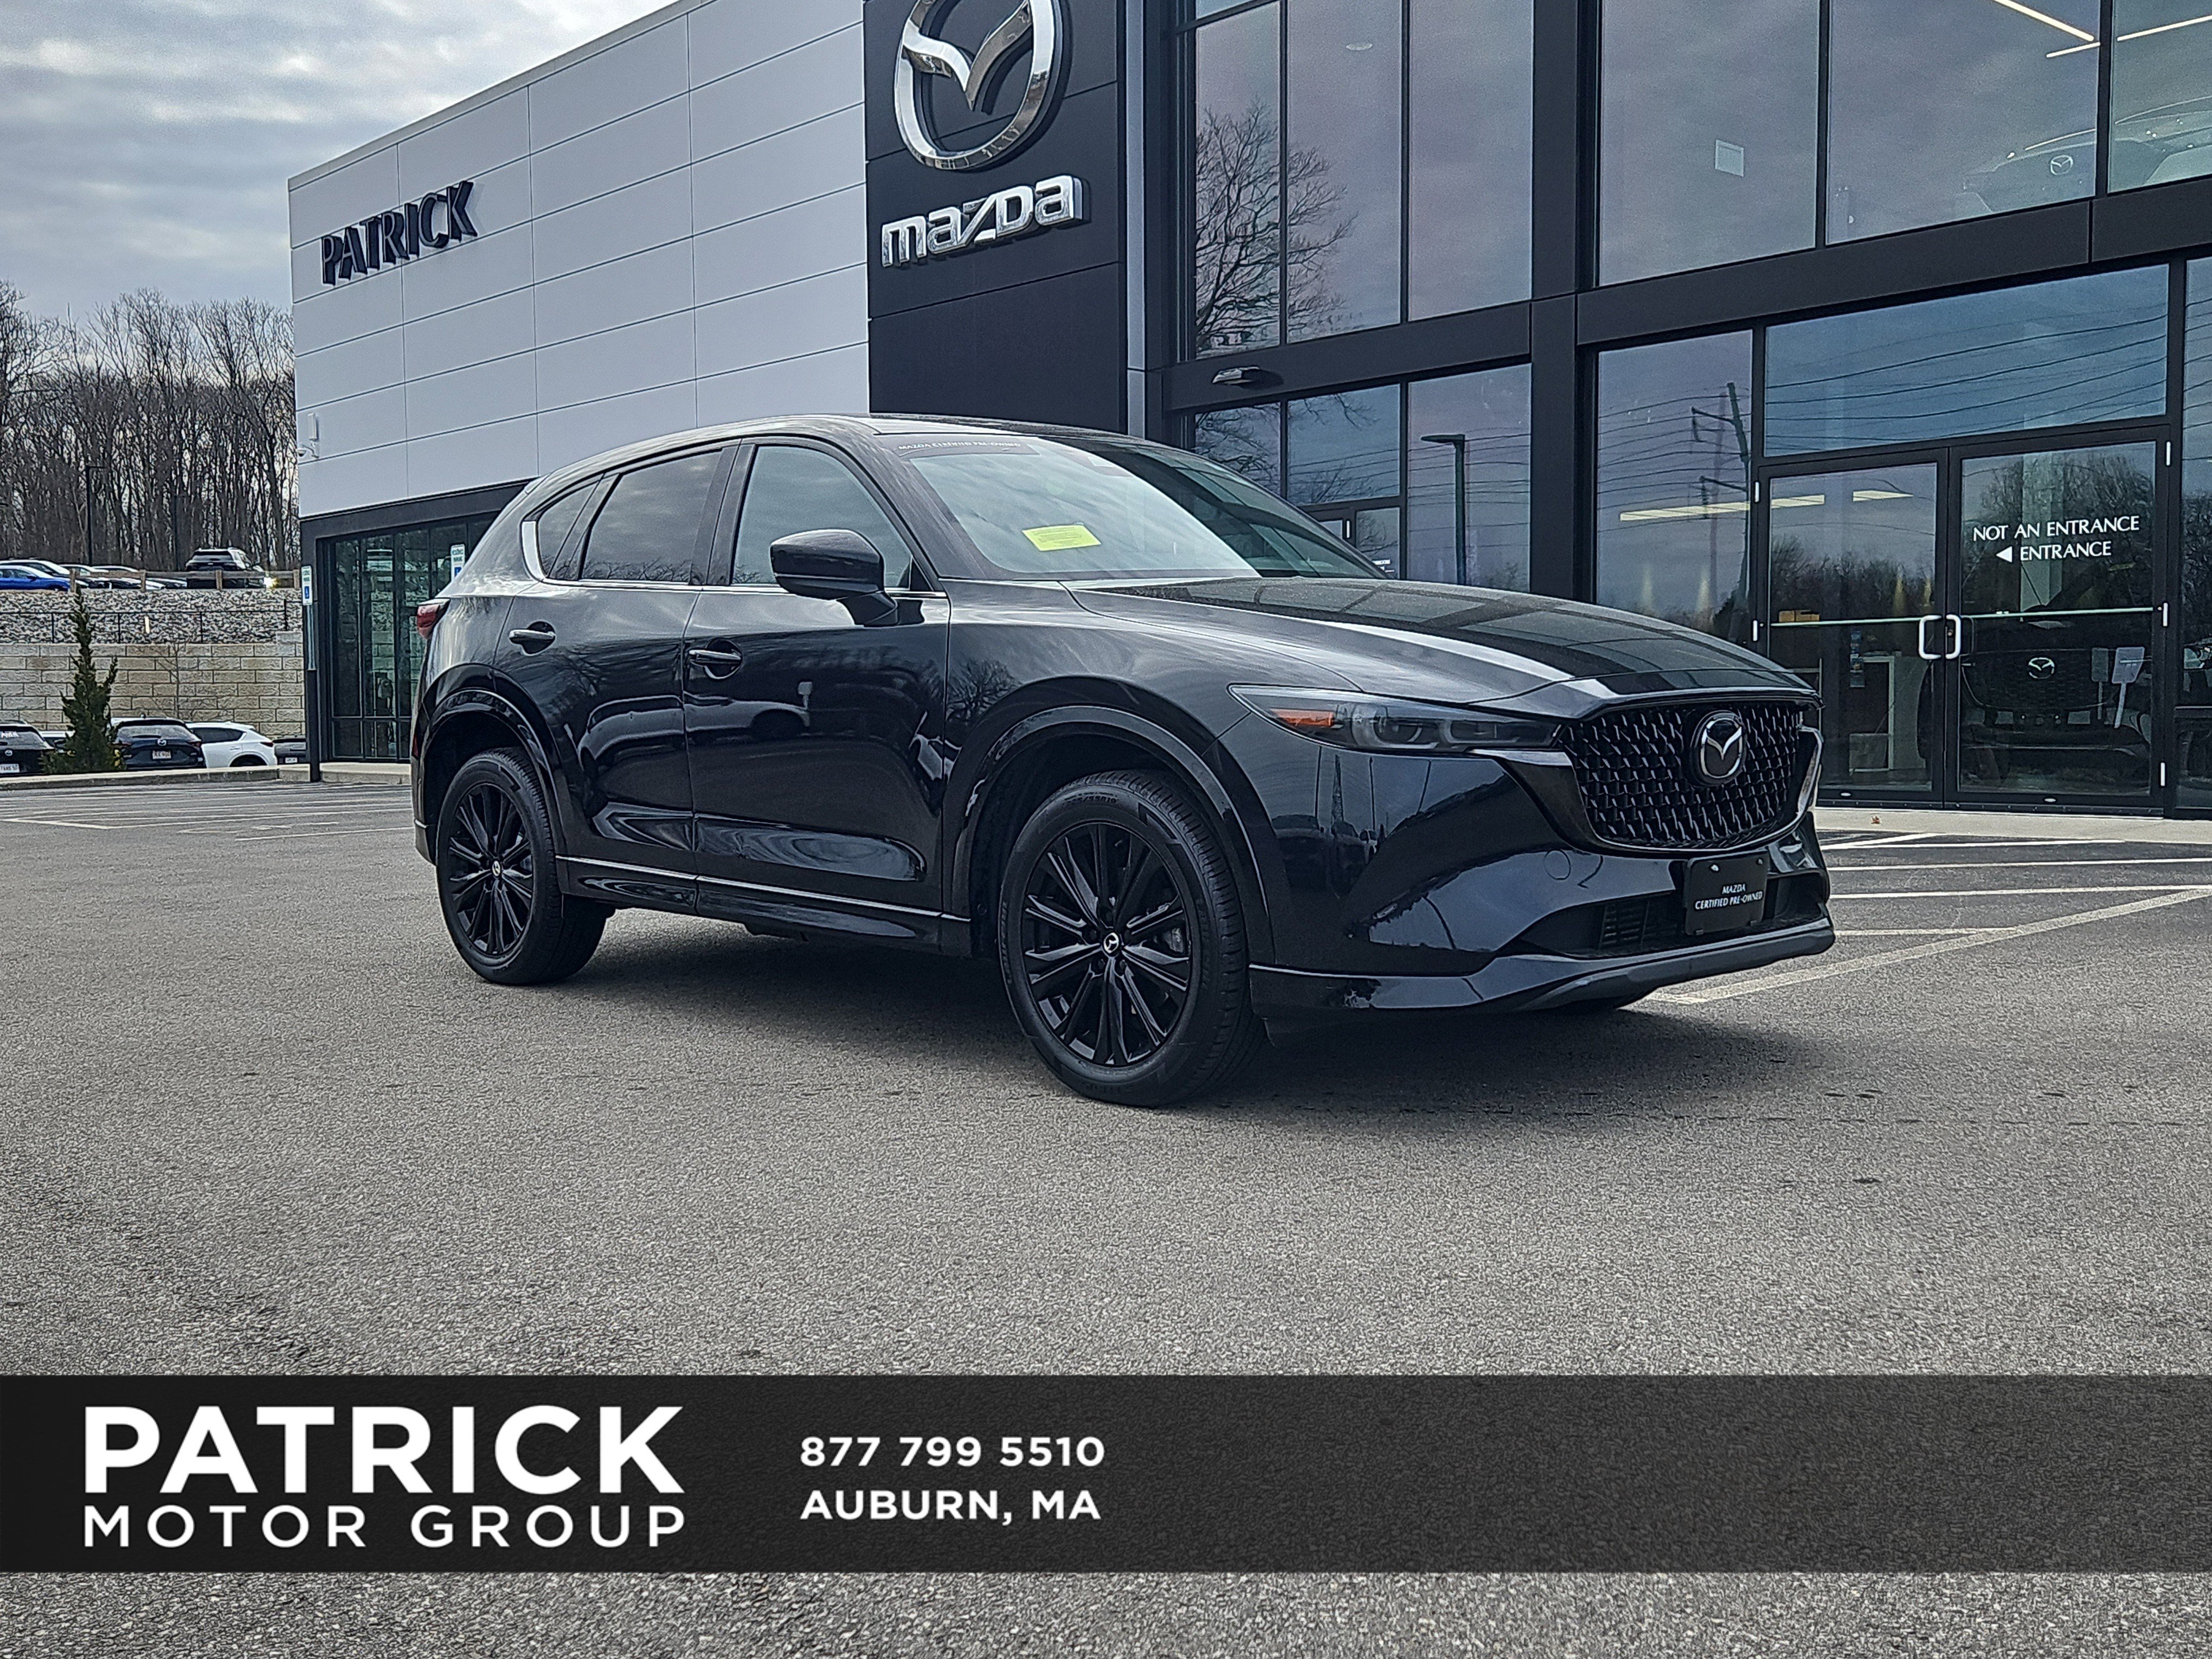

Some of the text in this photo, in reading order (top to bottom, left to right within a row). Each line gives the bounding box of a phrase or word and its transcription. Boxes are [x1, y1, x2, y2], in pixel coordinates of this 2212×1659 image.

[881, 175, 1083, 267] mazda
[321, 180, 478, 286] PATRICK
[1973, 516, 2140, 542] NOT AN ENTRANCE
[2020, 541, 2112, 561] ENTRANCE
[1722, 883, 1746, 895] MAZDA
[1695, 897, 1728, 910] CERTIFIED
